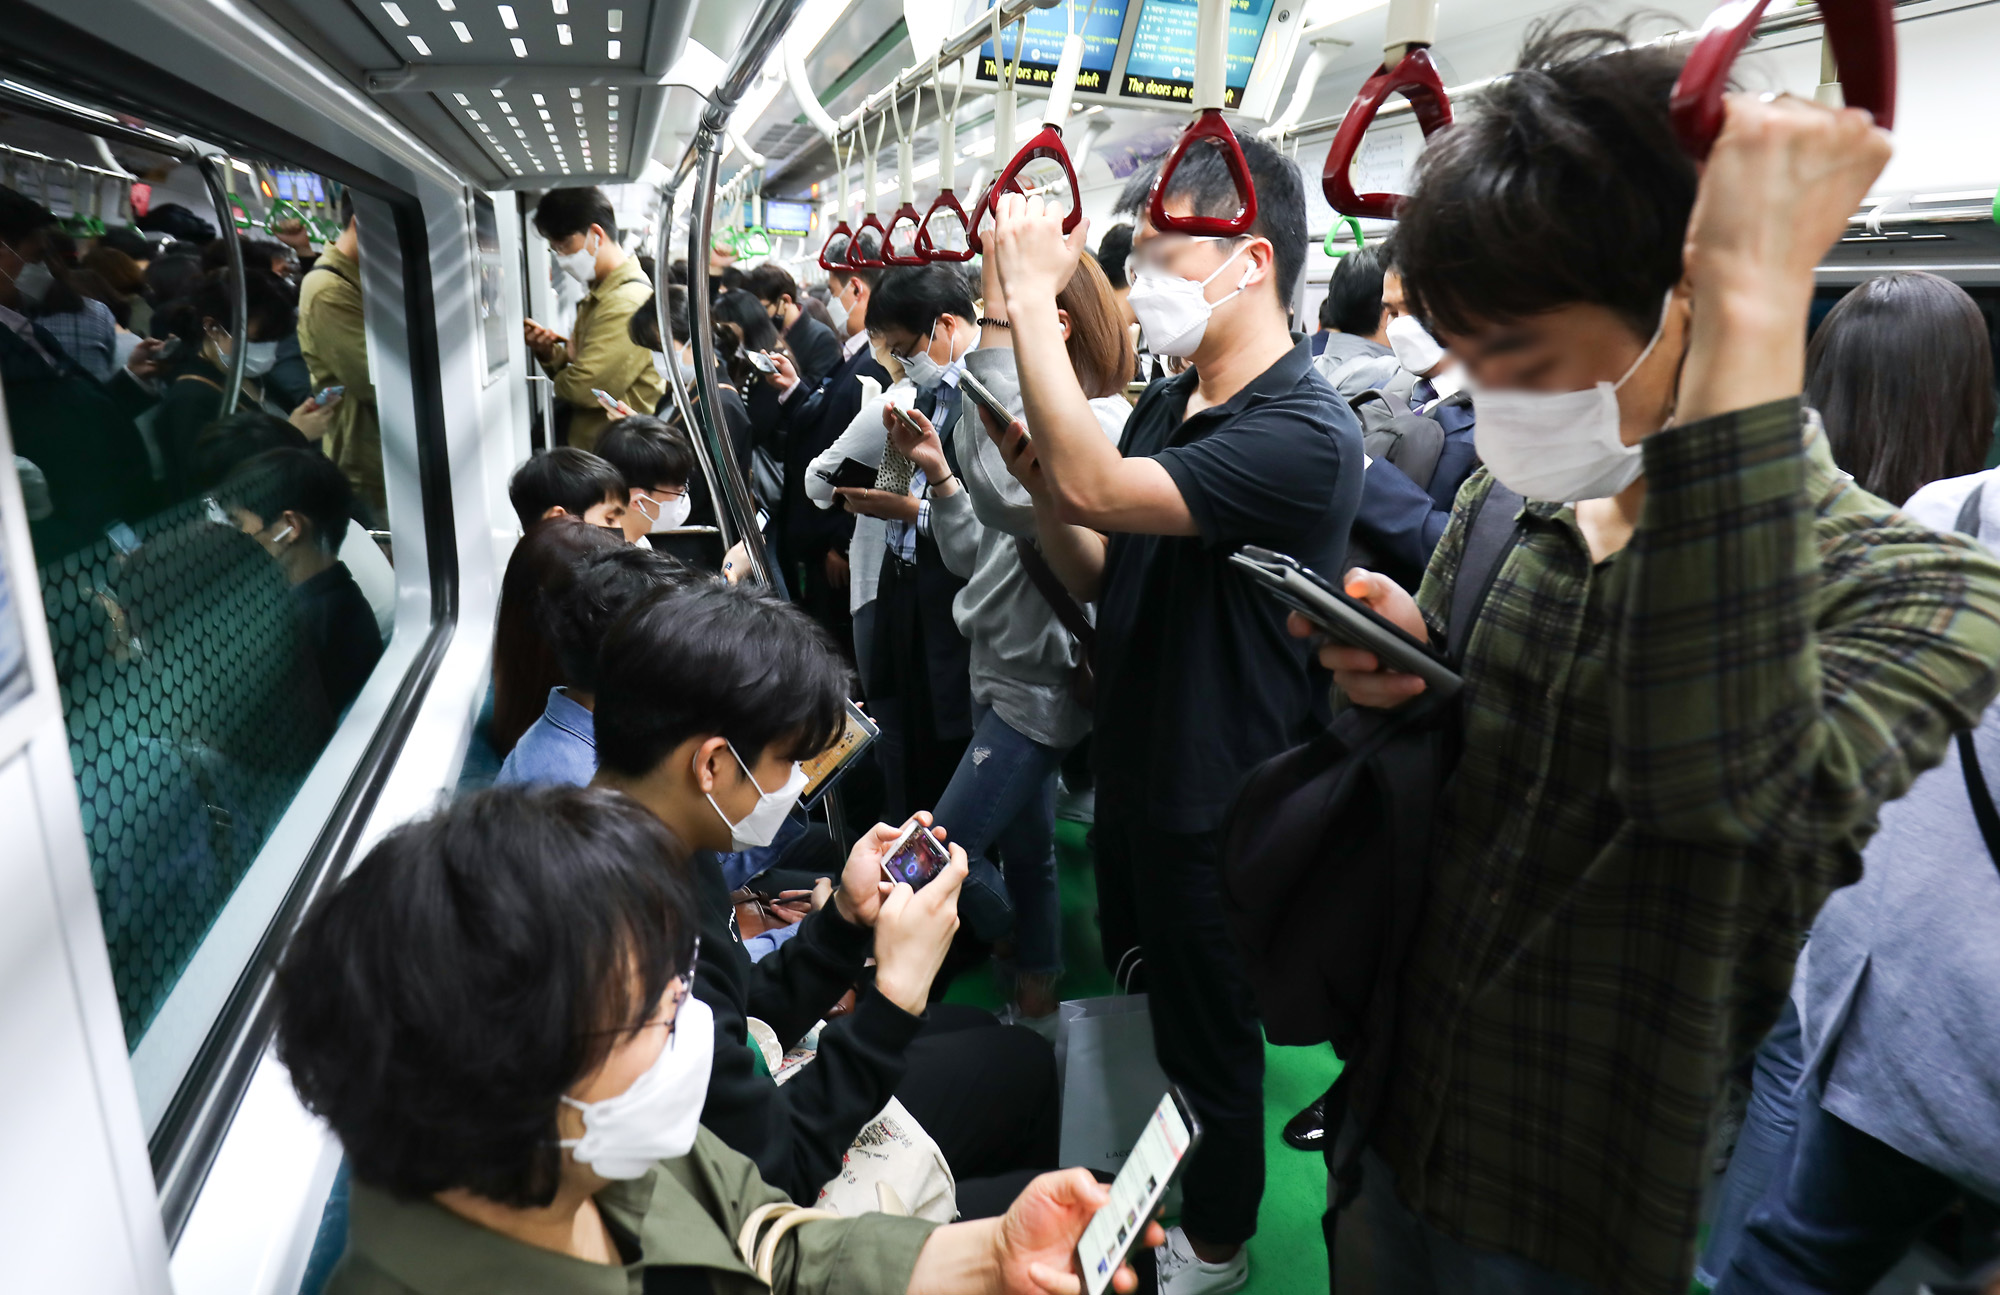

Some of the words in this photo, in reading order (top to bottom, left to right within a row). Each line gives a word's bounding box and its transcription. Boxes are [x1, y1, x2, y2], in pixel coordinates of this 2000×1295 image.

[984, 60, 997, 76] Th
[1004, 62, 1032, 80] dors
[1033, 69, 1049, 82] are
[1128, 77, 1144, 94] The
[1146, 79, 1172, 97] doors
[1172, 85, 1187, 99] are
